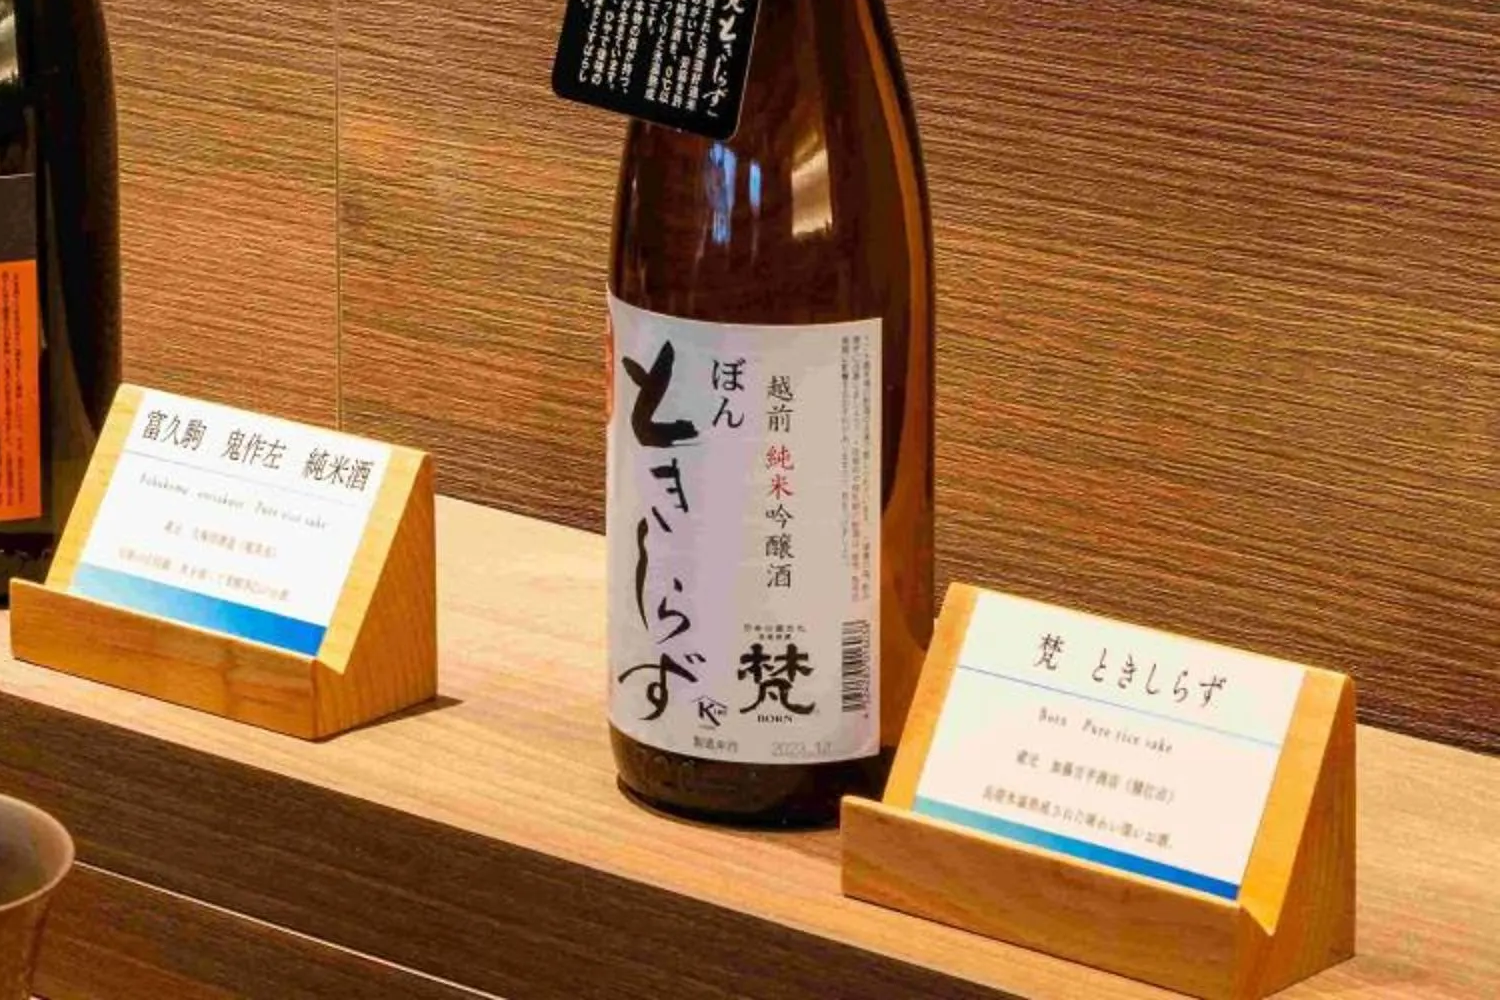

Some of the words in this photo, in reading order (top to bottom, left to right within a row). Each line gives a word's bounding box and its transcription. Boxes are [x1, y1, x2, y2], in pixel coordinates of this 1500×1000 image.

[711, 357, 746, 430] ぼん
[142, 409, 208, 451] 富久駒
[220, 427, 288, 471] 鬼作左
[302, 446, 375, 491] 純米酒
[618, 339, 706, 720] ときしらず
[737, 643, 816, 714] 梵
[1033, 631, 1066, 672] 梵
[1091, 647, 1227, 708] ときしらず
[757, 714, 793, 723] BORN
[1082, 718, 1112, 738] Pure
[1115, 729, 1141, 745] rice
[1145, 737, 1173, 754] sake
